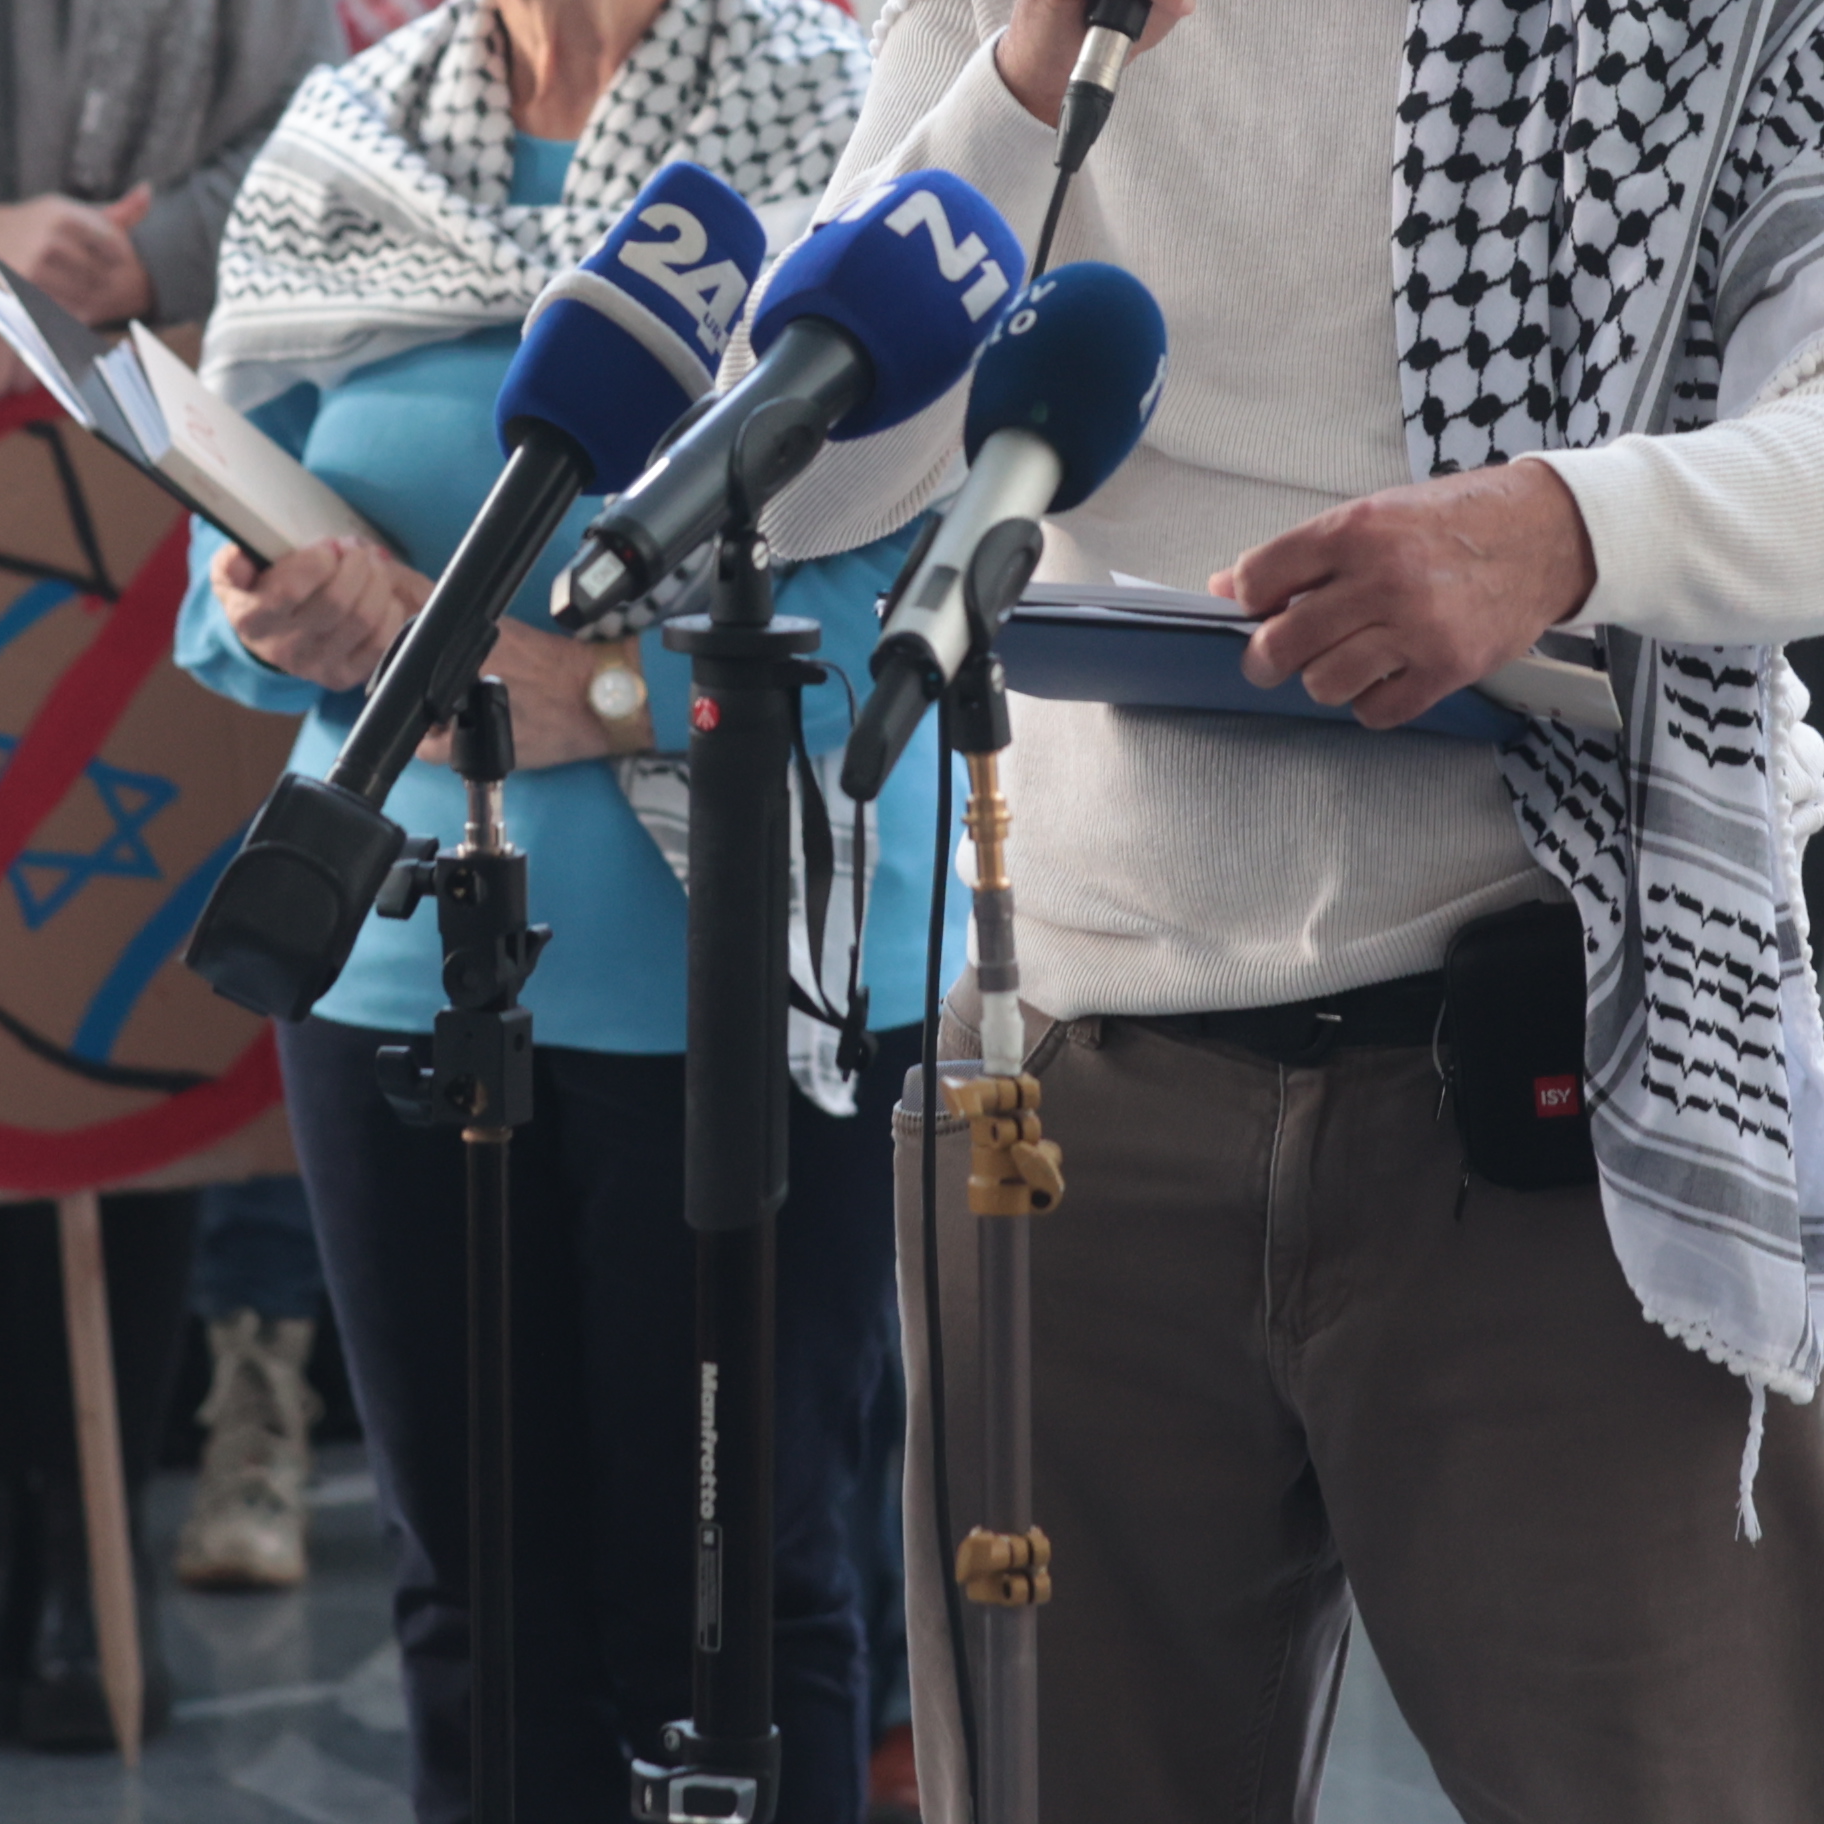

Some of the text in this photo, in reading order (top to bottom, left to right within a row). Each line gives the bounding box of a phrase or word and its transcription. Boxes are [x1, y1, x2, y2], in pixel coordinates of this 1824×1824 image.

[617, 202, 749, 357] 24
[883, 189, 1010, 324] N1
[1539, 1087, 1572, 1106] ISY
[700, 1360, 719, 1521] Manfrotto
